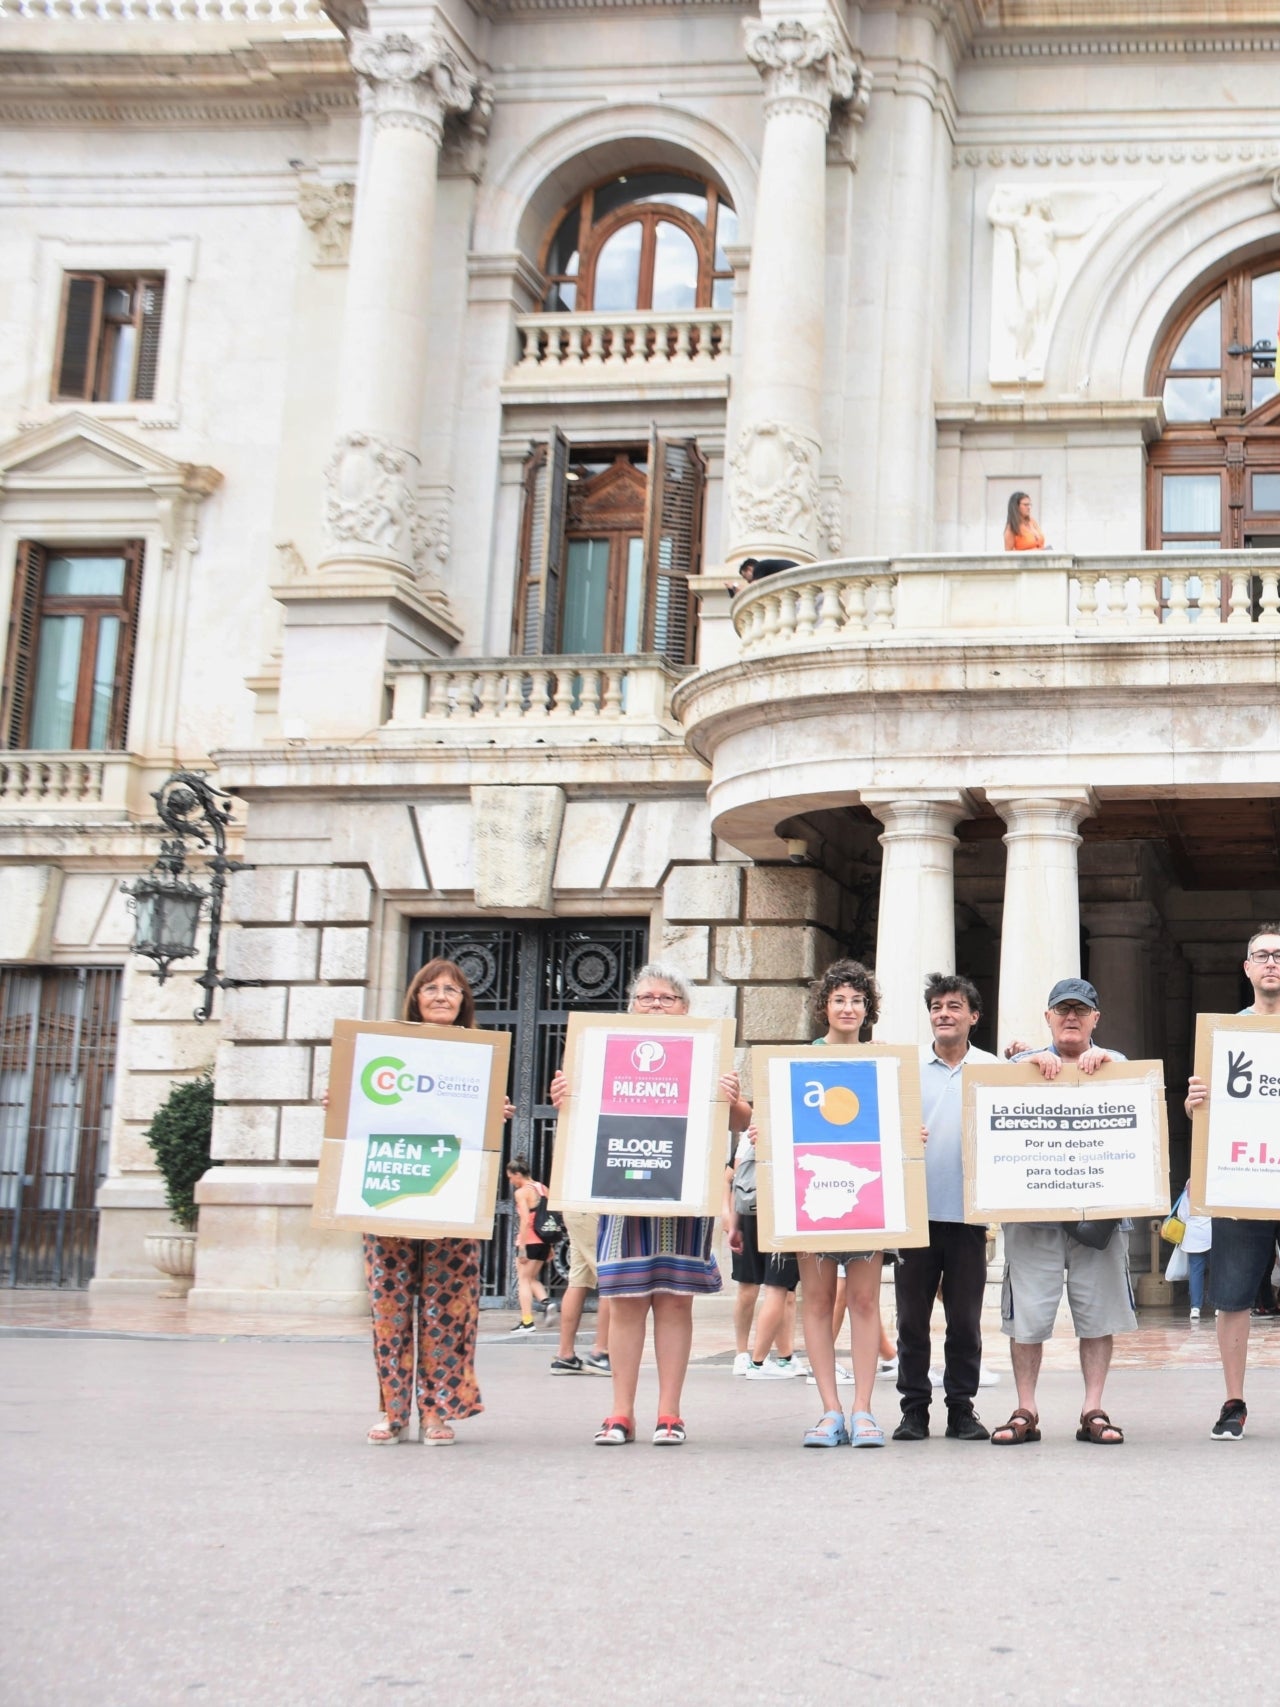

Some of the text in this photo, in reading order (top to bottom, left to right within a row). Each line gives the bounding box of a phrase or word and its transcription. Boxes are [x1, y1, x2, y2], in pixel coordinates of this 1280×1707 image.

[438, 1080, 480, 1093] Centro
[612, 1080, 678, 1098] PALENCIA
[992, 1102, 1136, 1116] La ciudadanía tiene
[994, 1116, 1133, 1130] derecho a conocer
[368, 1138, 422, 1160] JAÉN
[608, 1138, 674, 1156] BLOQUE
[1025, 1138, 1104, 1148] Por un debate
[606, 1157, 672, 1170] EXTREMEÑO
[993, 1152, 1066, 1164] proporcional
[1079, 1150, 1136, 1164] igualitario
[366, 1160, 432, 1177] MERECE
[1026, 1166, 1104, 1177] para todas las
[364, 1174, 401, 1192] MÁS
[813, 1180, 855, 1190] UNIDOS
[1026, 1180, 1104, 1190] candidaturas.
